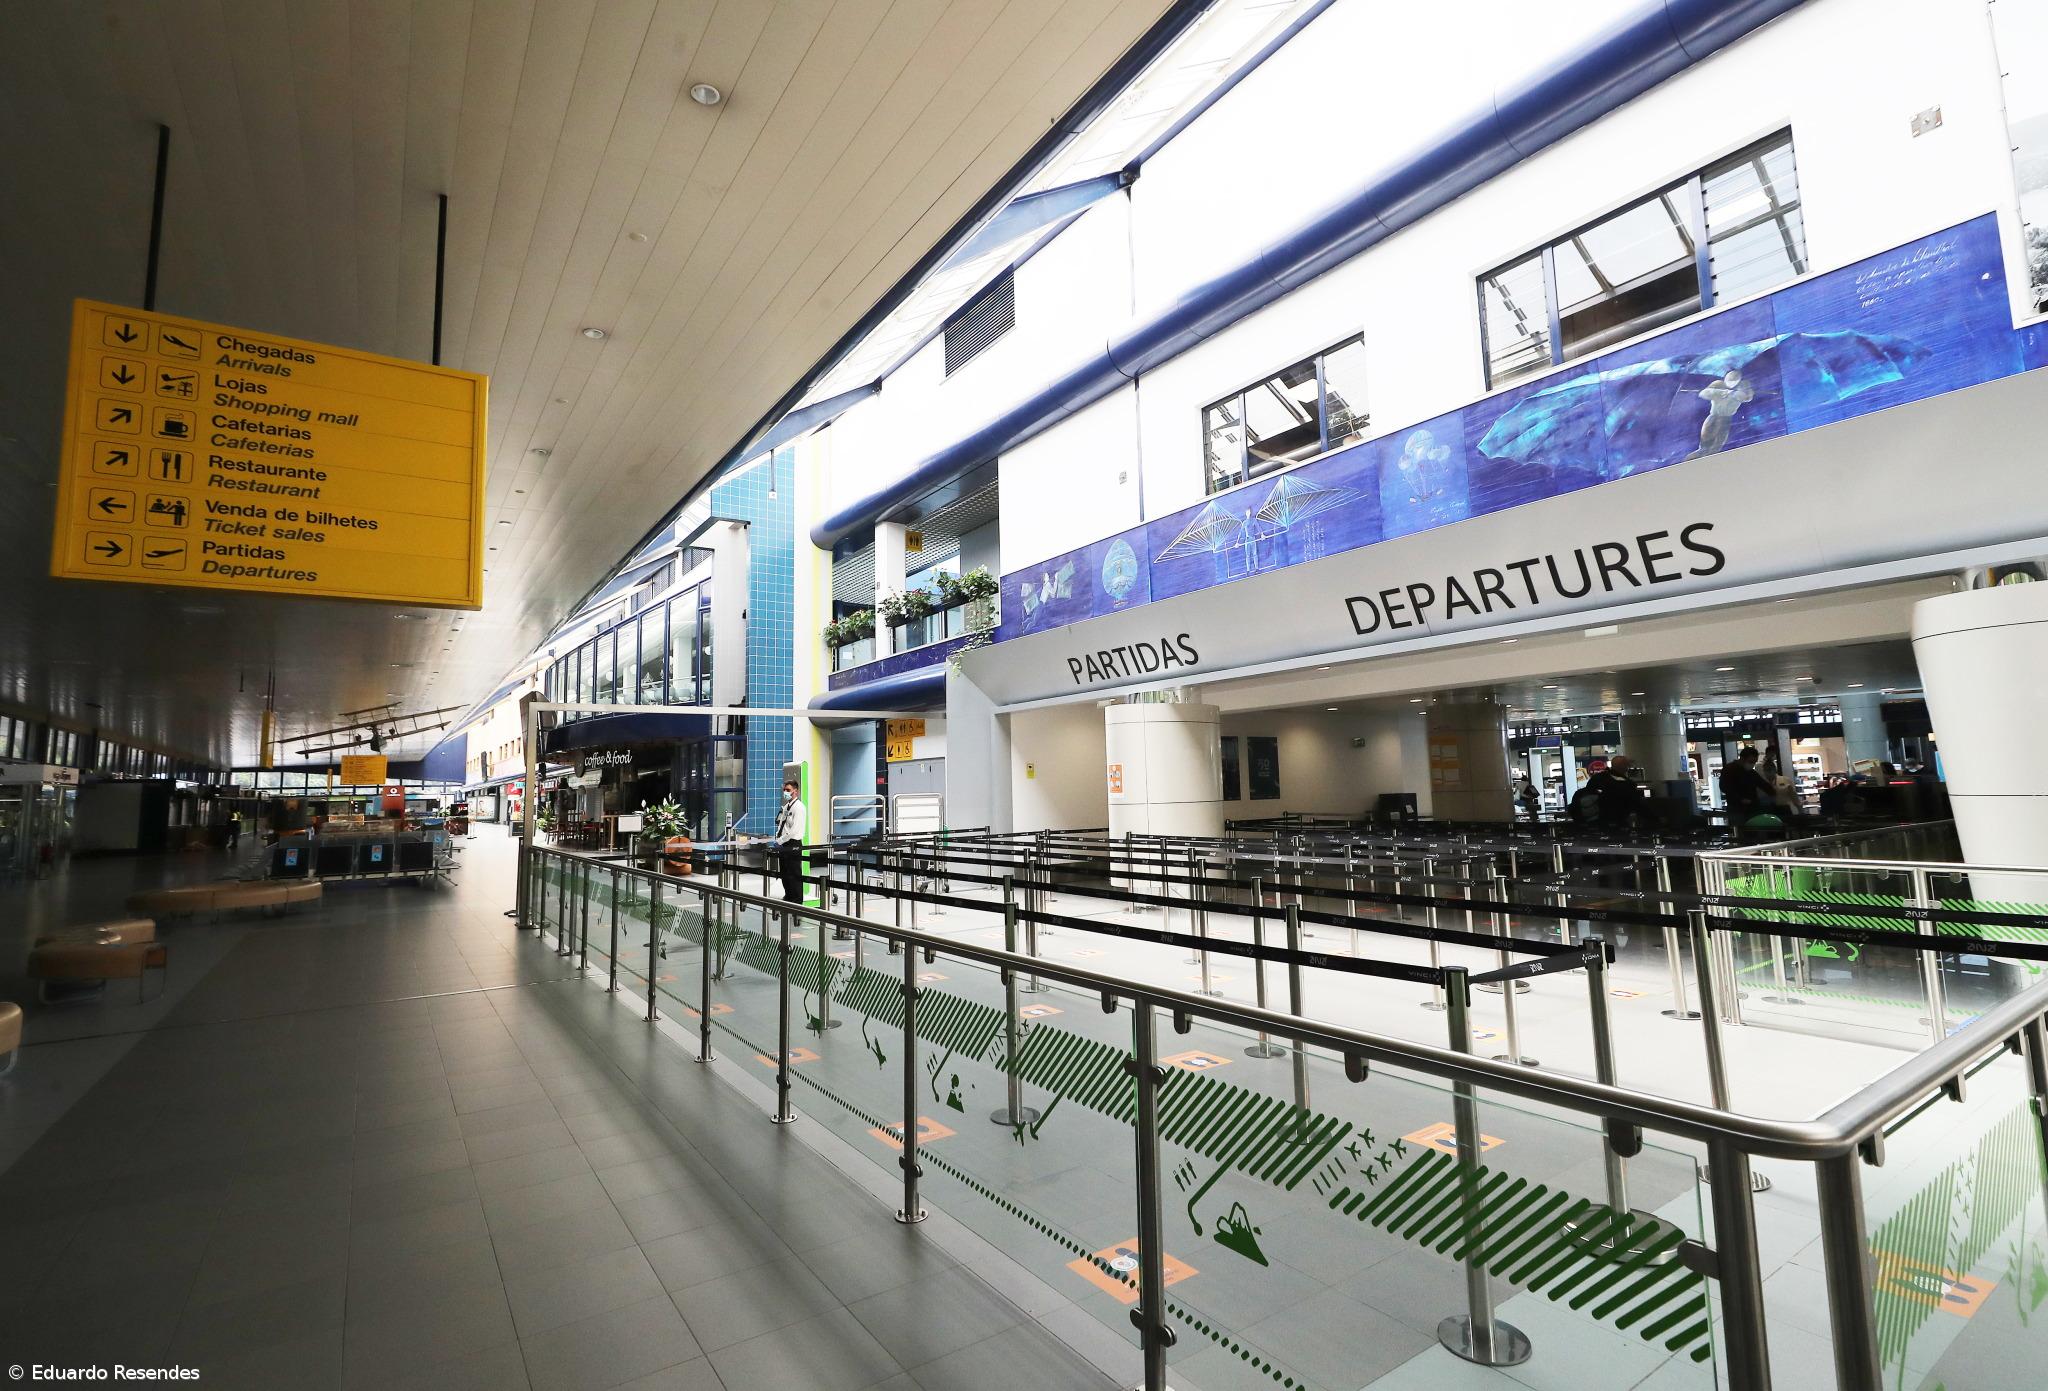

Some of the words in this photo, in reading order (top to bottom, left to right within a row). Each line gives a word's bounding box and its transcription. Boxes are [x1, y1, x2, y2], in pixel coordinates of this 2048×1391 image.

[216, 334, 316, 365] Chegadas
[215, 354, 292, 378] Arrivals
[214, 374, 268, 396] Lojas
[213, 392, 312, 422] Shopping
[316, 409, 359, 428] mall
[211, 414, 312, 441] Cafetarias
[210, 433, 315, 460] Cafeterias
[208, 454, 328, 483] Restaurante
[207, 474, 321, 500] Restaurant
[205, 499, 268, 520] Venda
[274, 507, 300, 523] de
[306, 509, 379, 532] bilhetes
[204, 518, 267, 538] Ticket
[272, 525, 326, 544] sales
[202, 540, 286, 561] Partidas
[201, 559, 318, 584] Departures
[1345, 521, 1726, 636] DEPARTURES
[1066, 632, 1200, 686] PARTIDAS
[612, 749, 633, 767] food
